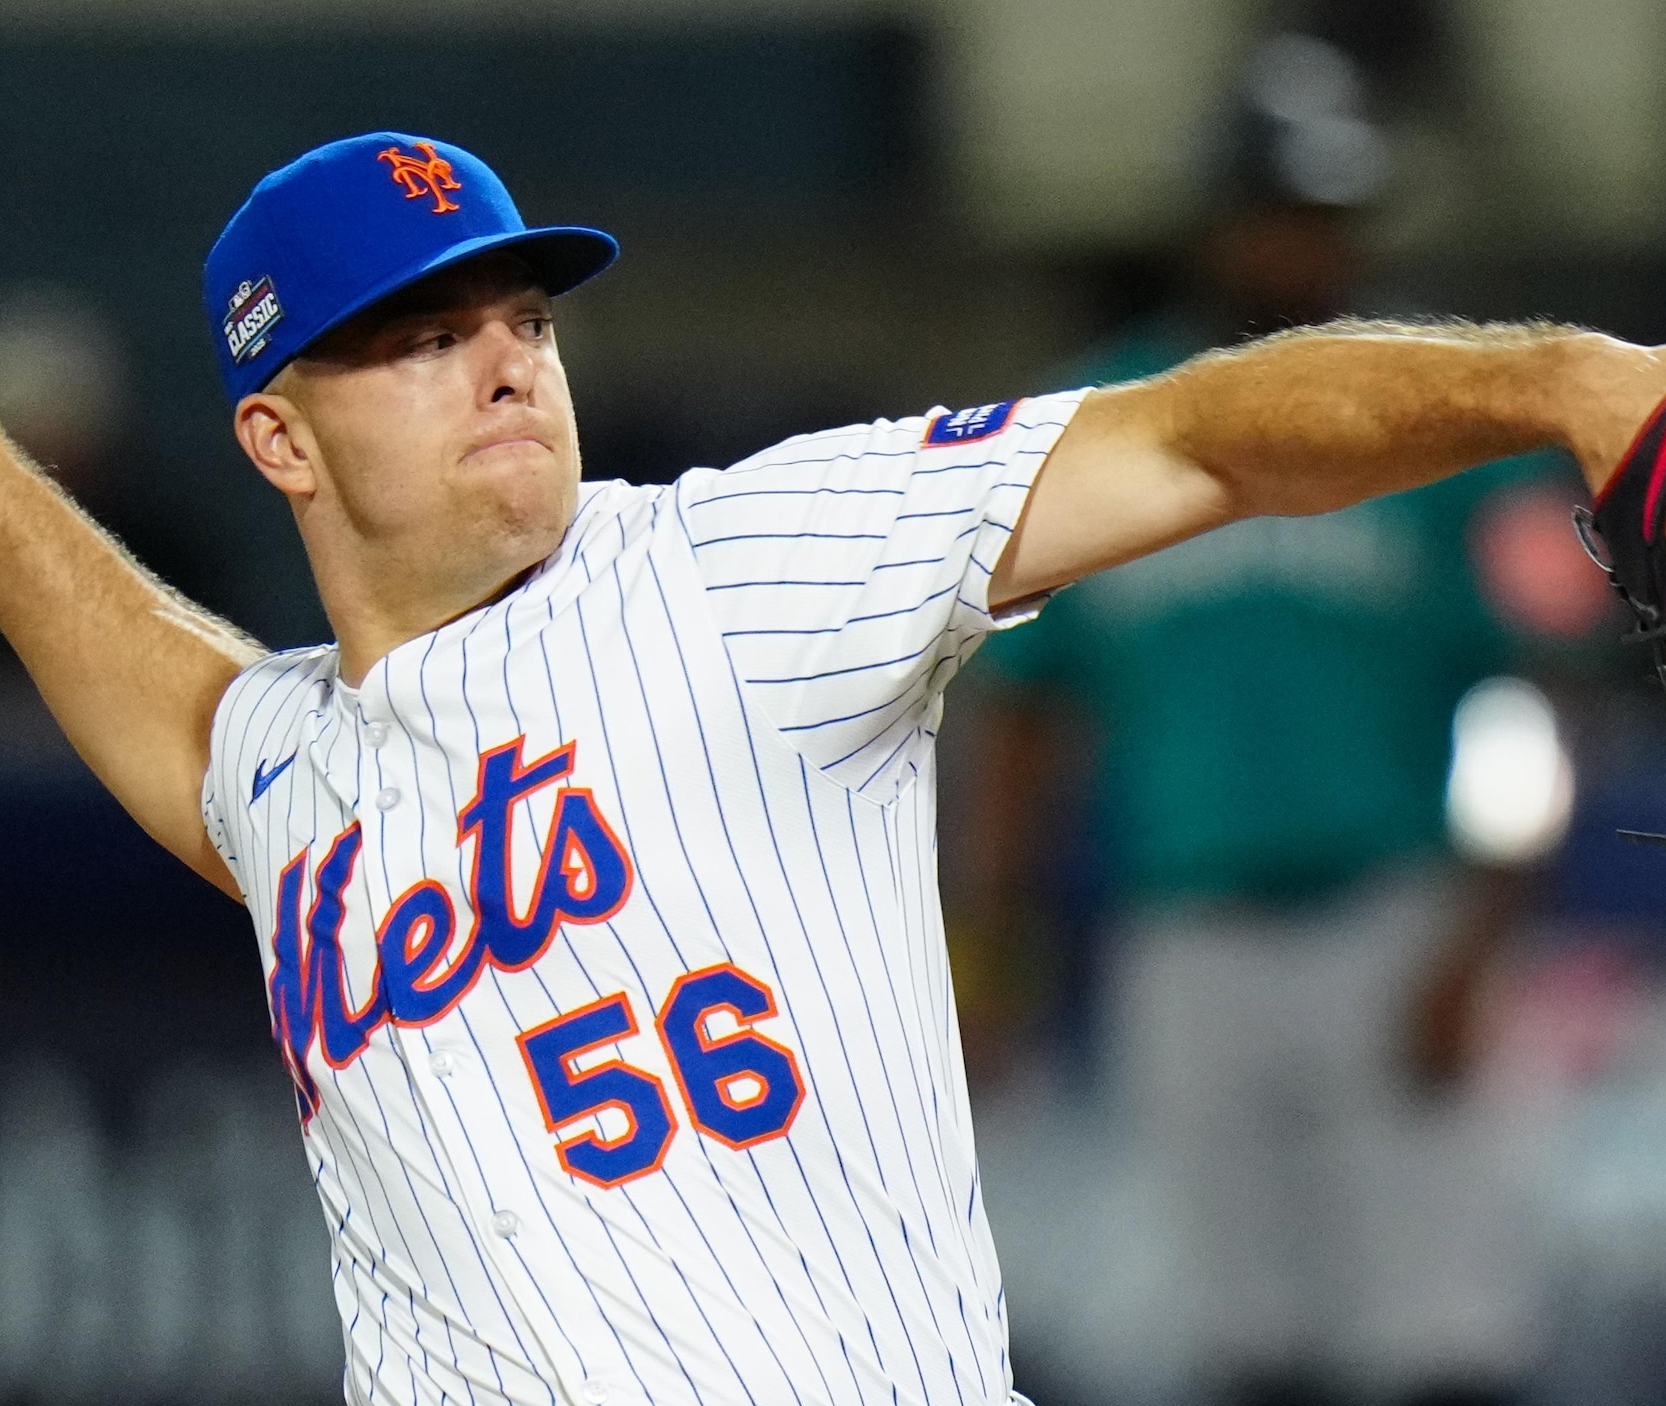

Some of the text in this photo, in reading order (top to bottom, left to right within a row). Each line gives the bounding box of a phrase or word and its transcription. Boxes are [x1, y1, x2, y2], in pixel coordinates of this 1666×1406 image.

[377, 142, 462, 213] NY
[227, 292, 279, 357] CLASSIC
[270, 733, 634, 1136] Mets
[515, 961, 807, 1190] 56
